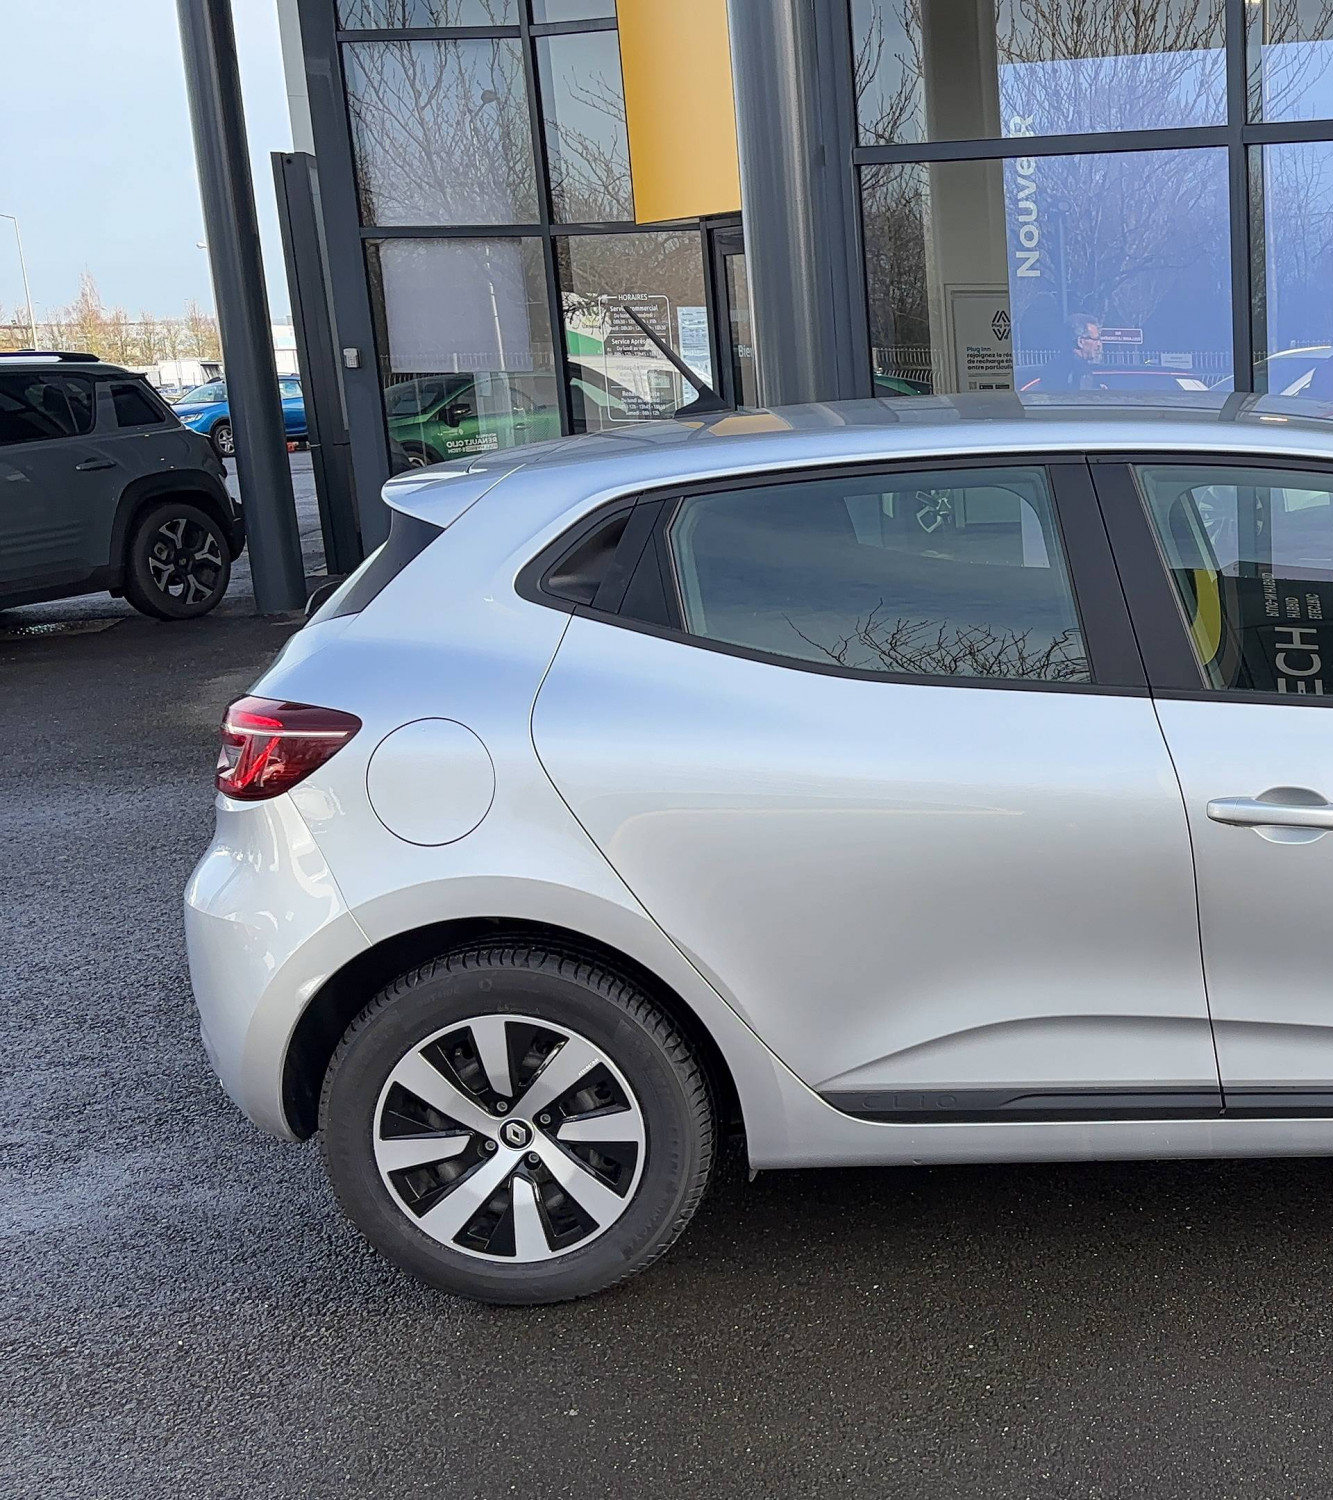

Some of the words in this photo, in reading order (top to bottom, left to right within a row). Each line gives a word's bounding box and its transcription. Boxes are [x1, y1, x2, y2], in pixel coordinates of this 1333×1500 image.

[618, 293, 648, 301] HORAIRES
[966, 346, 980, 354] Plug
[861, 1095, 958, 1110] CLIO
